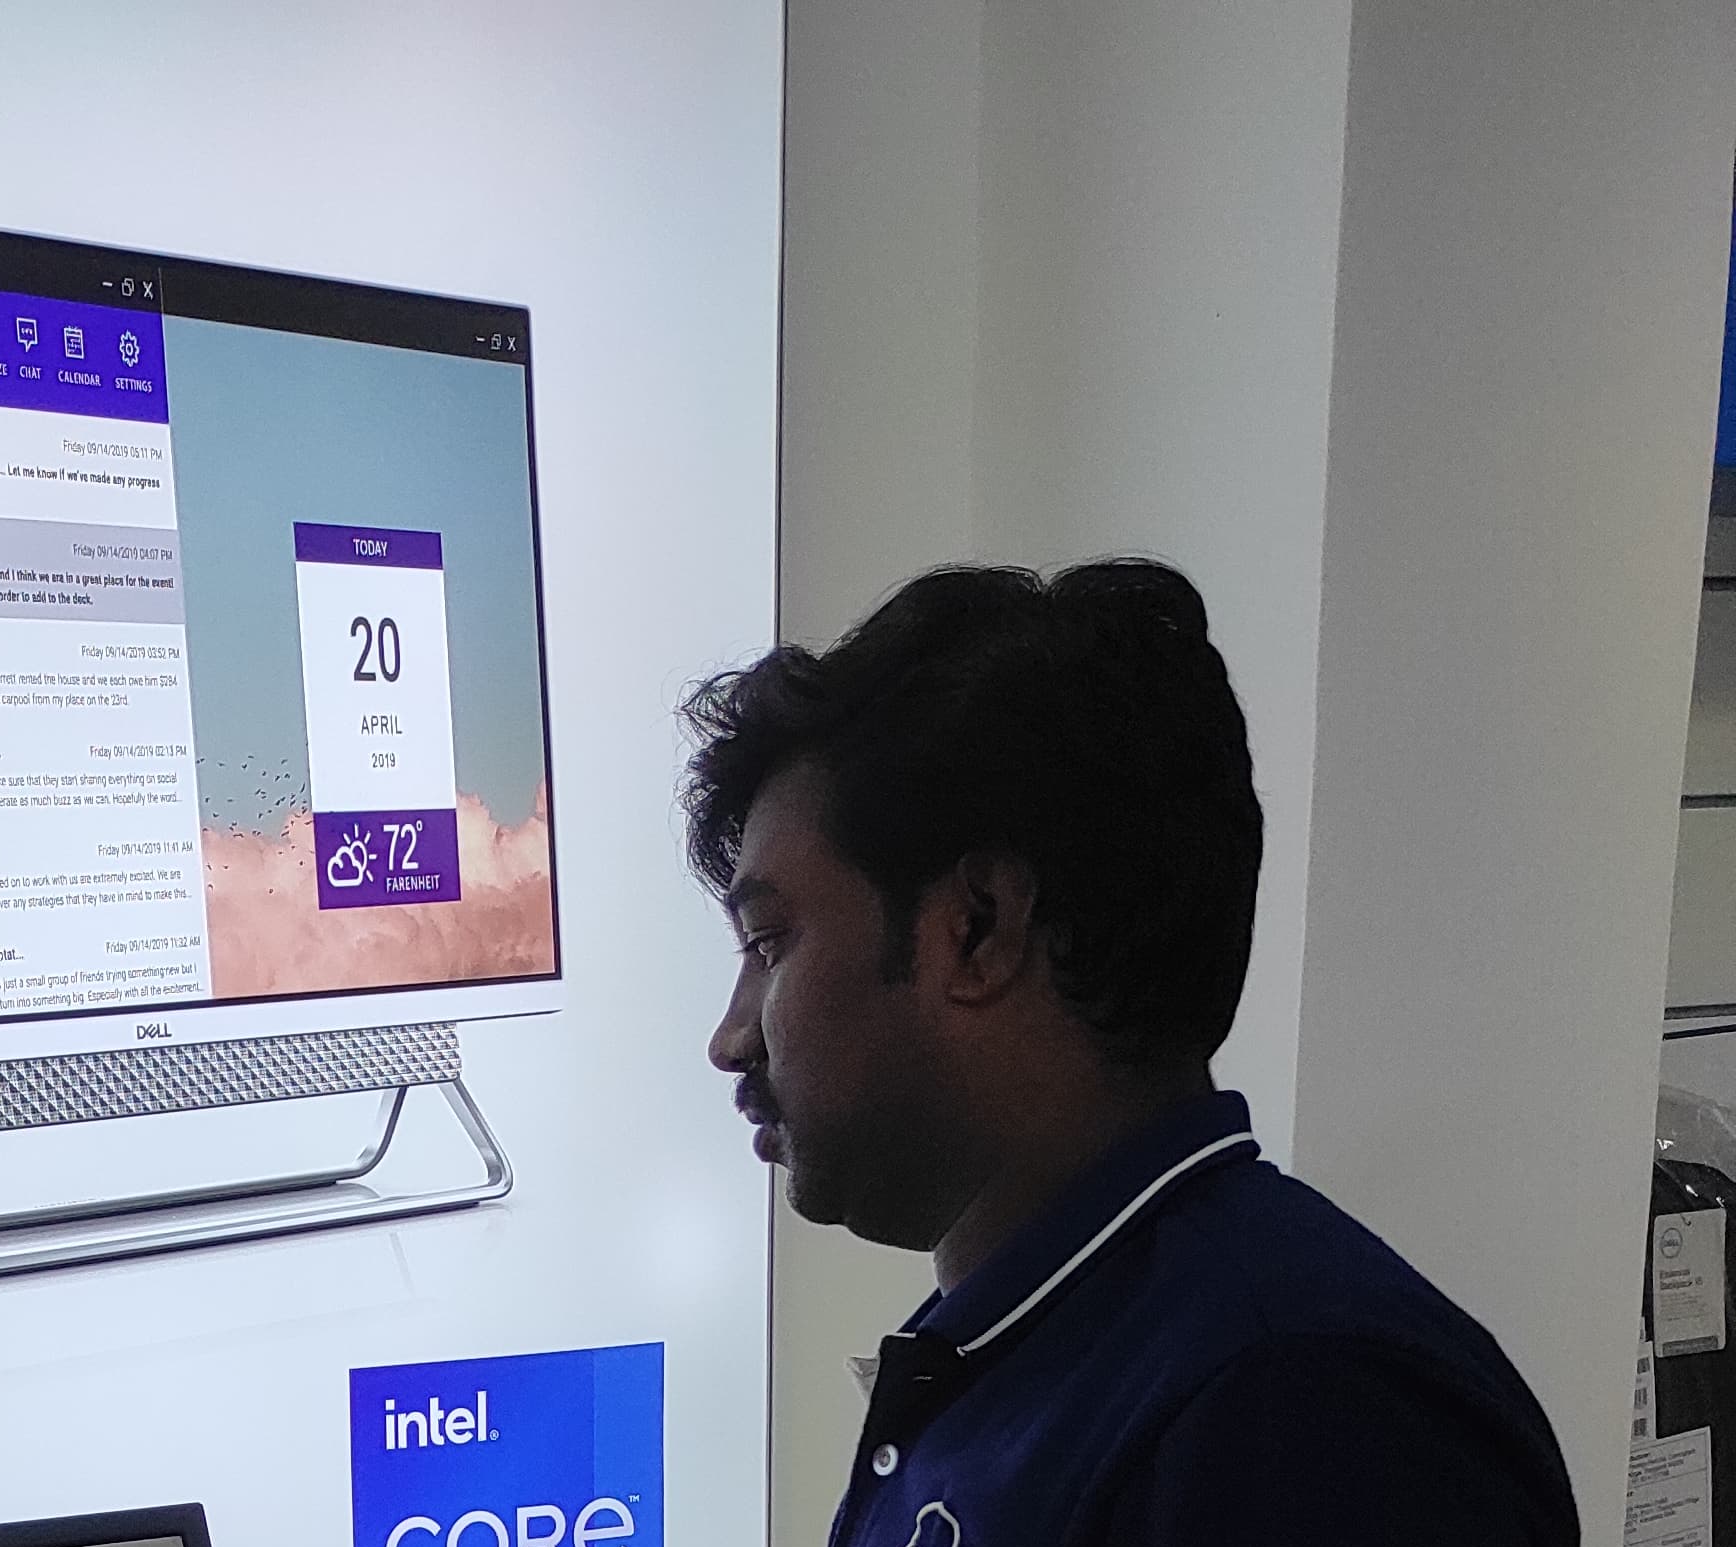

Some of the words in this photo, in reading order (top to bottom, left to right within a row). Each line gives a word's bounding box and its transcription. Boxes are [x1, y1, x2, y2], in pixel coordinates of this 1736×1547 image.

[19, 366, 41, 380] CHAT
[58, 370, 101, 387] CALENDAR
[114, 377, 153, 393] SETTINGS
[353, 539, 387, 557] TODAY
[350, 616, 401, 682] 20
[361, 713, 403, 735] APRIL
[372, 752, 396, 768] 2019
[386, 874, 440, 893] FARENHEIT
[137, 1023, 172, 1040] DELL
